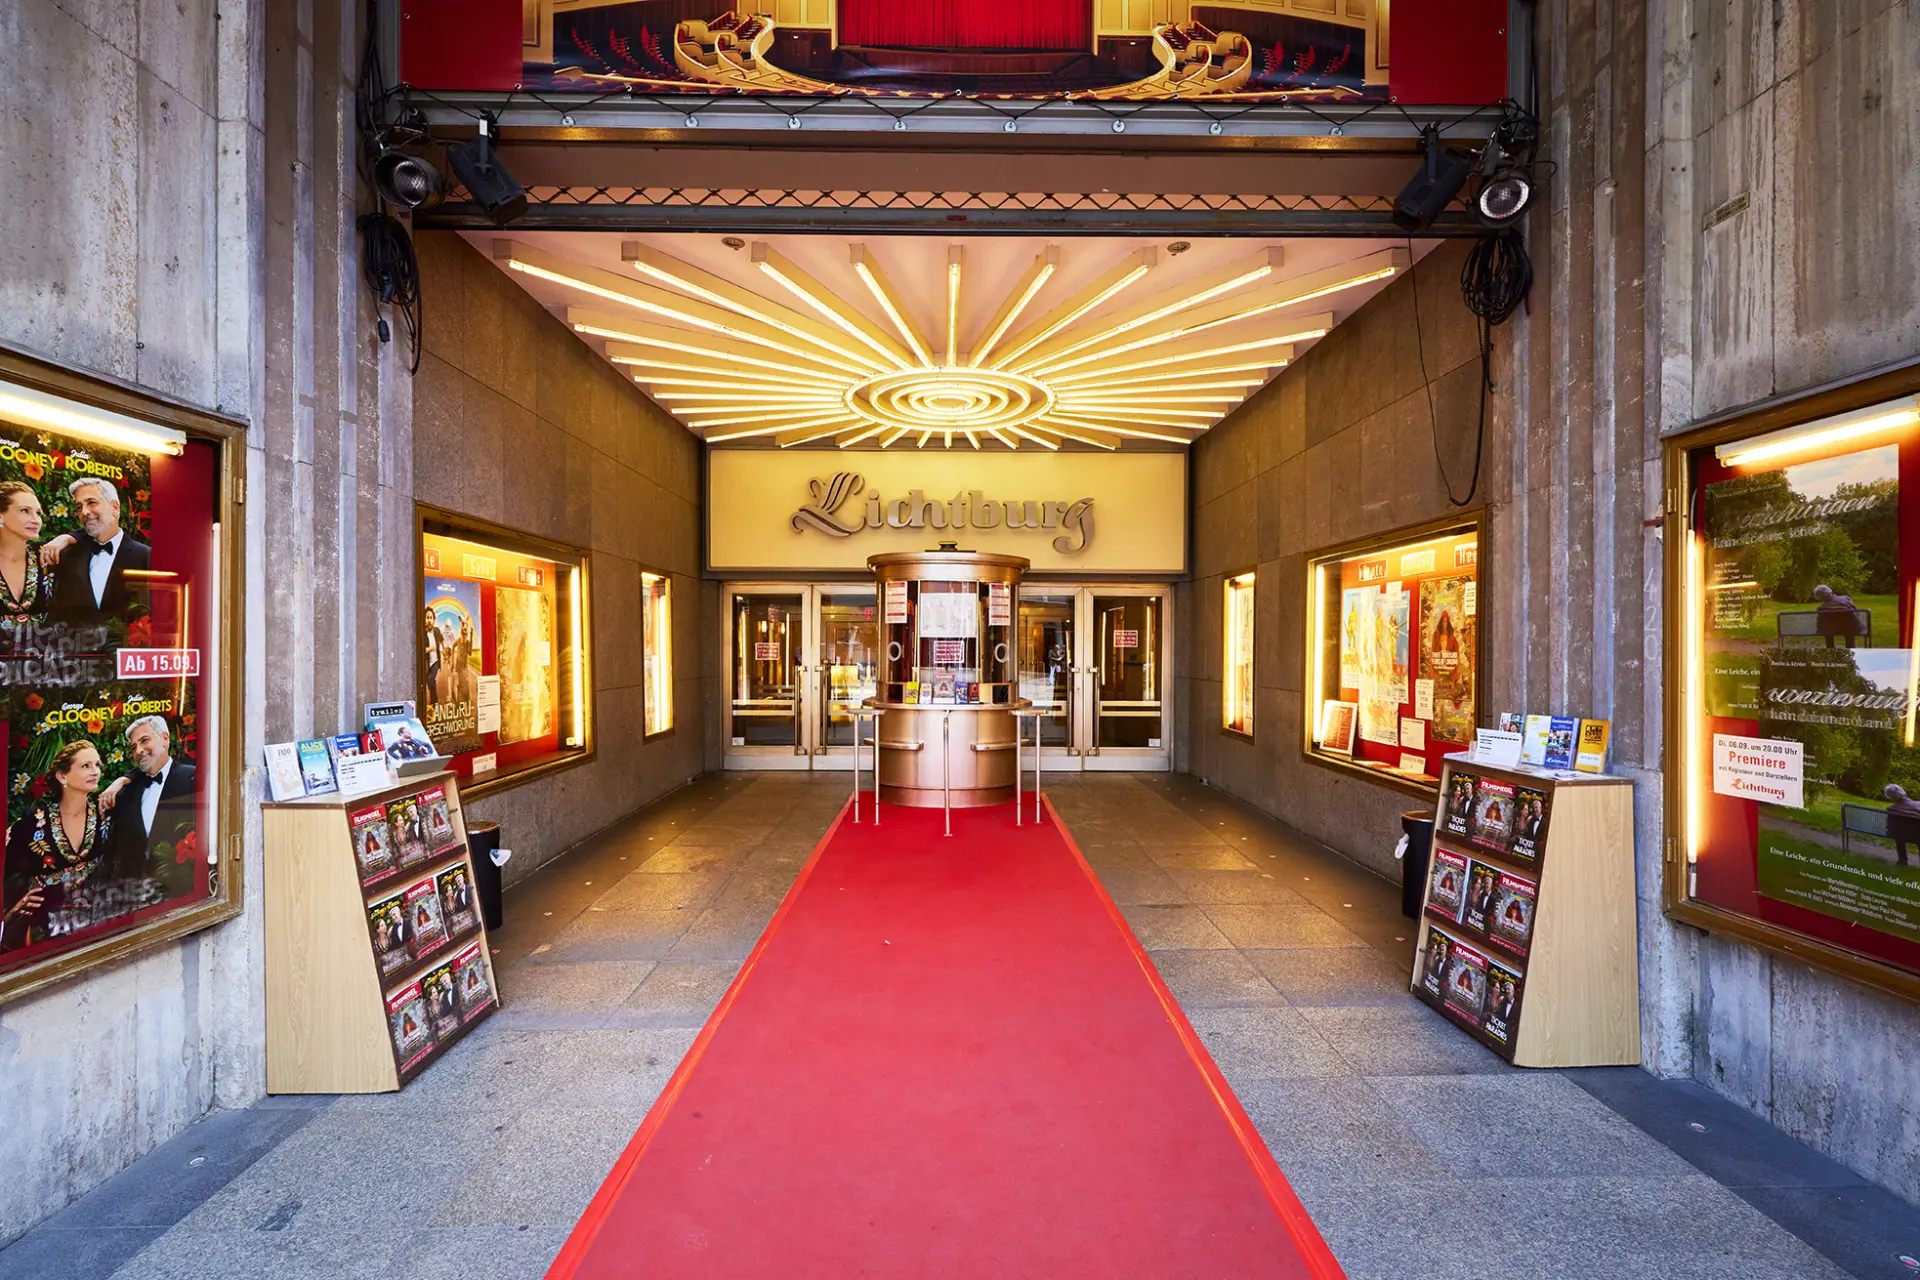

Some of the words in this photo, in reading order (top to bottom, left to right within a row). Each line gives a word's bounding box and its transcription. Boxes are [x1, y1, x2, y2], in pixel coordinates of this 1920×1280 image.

[65, 455, 123, 480] ROBERTS
[790, 471, 1095, 554] Lichtburg
[124, 655, 146, 672] Ab
[151, 655, 195, 671] 15.09.
[47, 706, 117, 725] CLOONEY
[122, 699, 172, 716] ROBERTS
[371, 706, 403, 716] trailer
[301, 740, 324, 751] ALICE
[1784, 747, 1798, 756] Uhr
[1729, 750, 1786, 770] Premiere
[1765, 772, 1798, 782] Darstellern
[1729, 777, 1786, 800] Lichtburg
[1769, 846, 1784, 857] Eine
[1809, 857, 1821, 866] ein
[1822, 859, 1866, 877] Grundstück
[1867, 871, 1883, 881] und
[1884, 875, 1903, 887] viele
